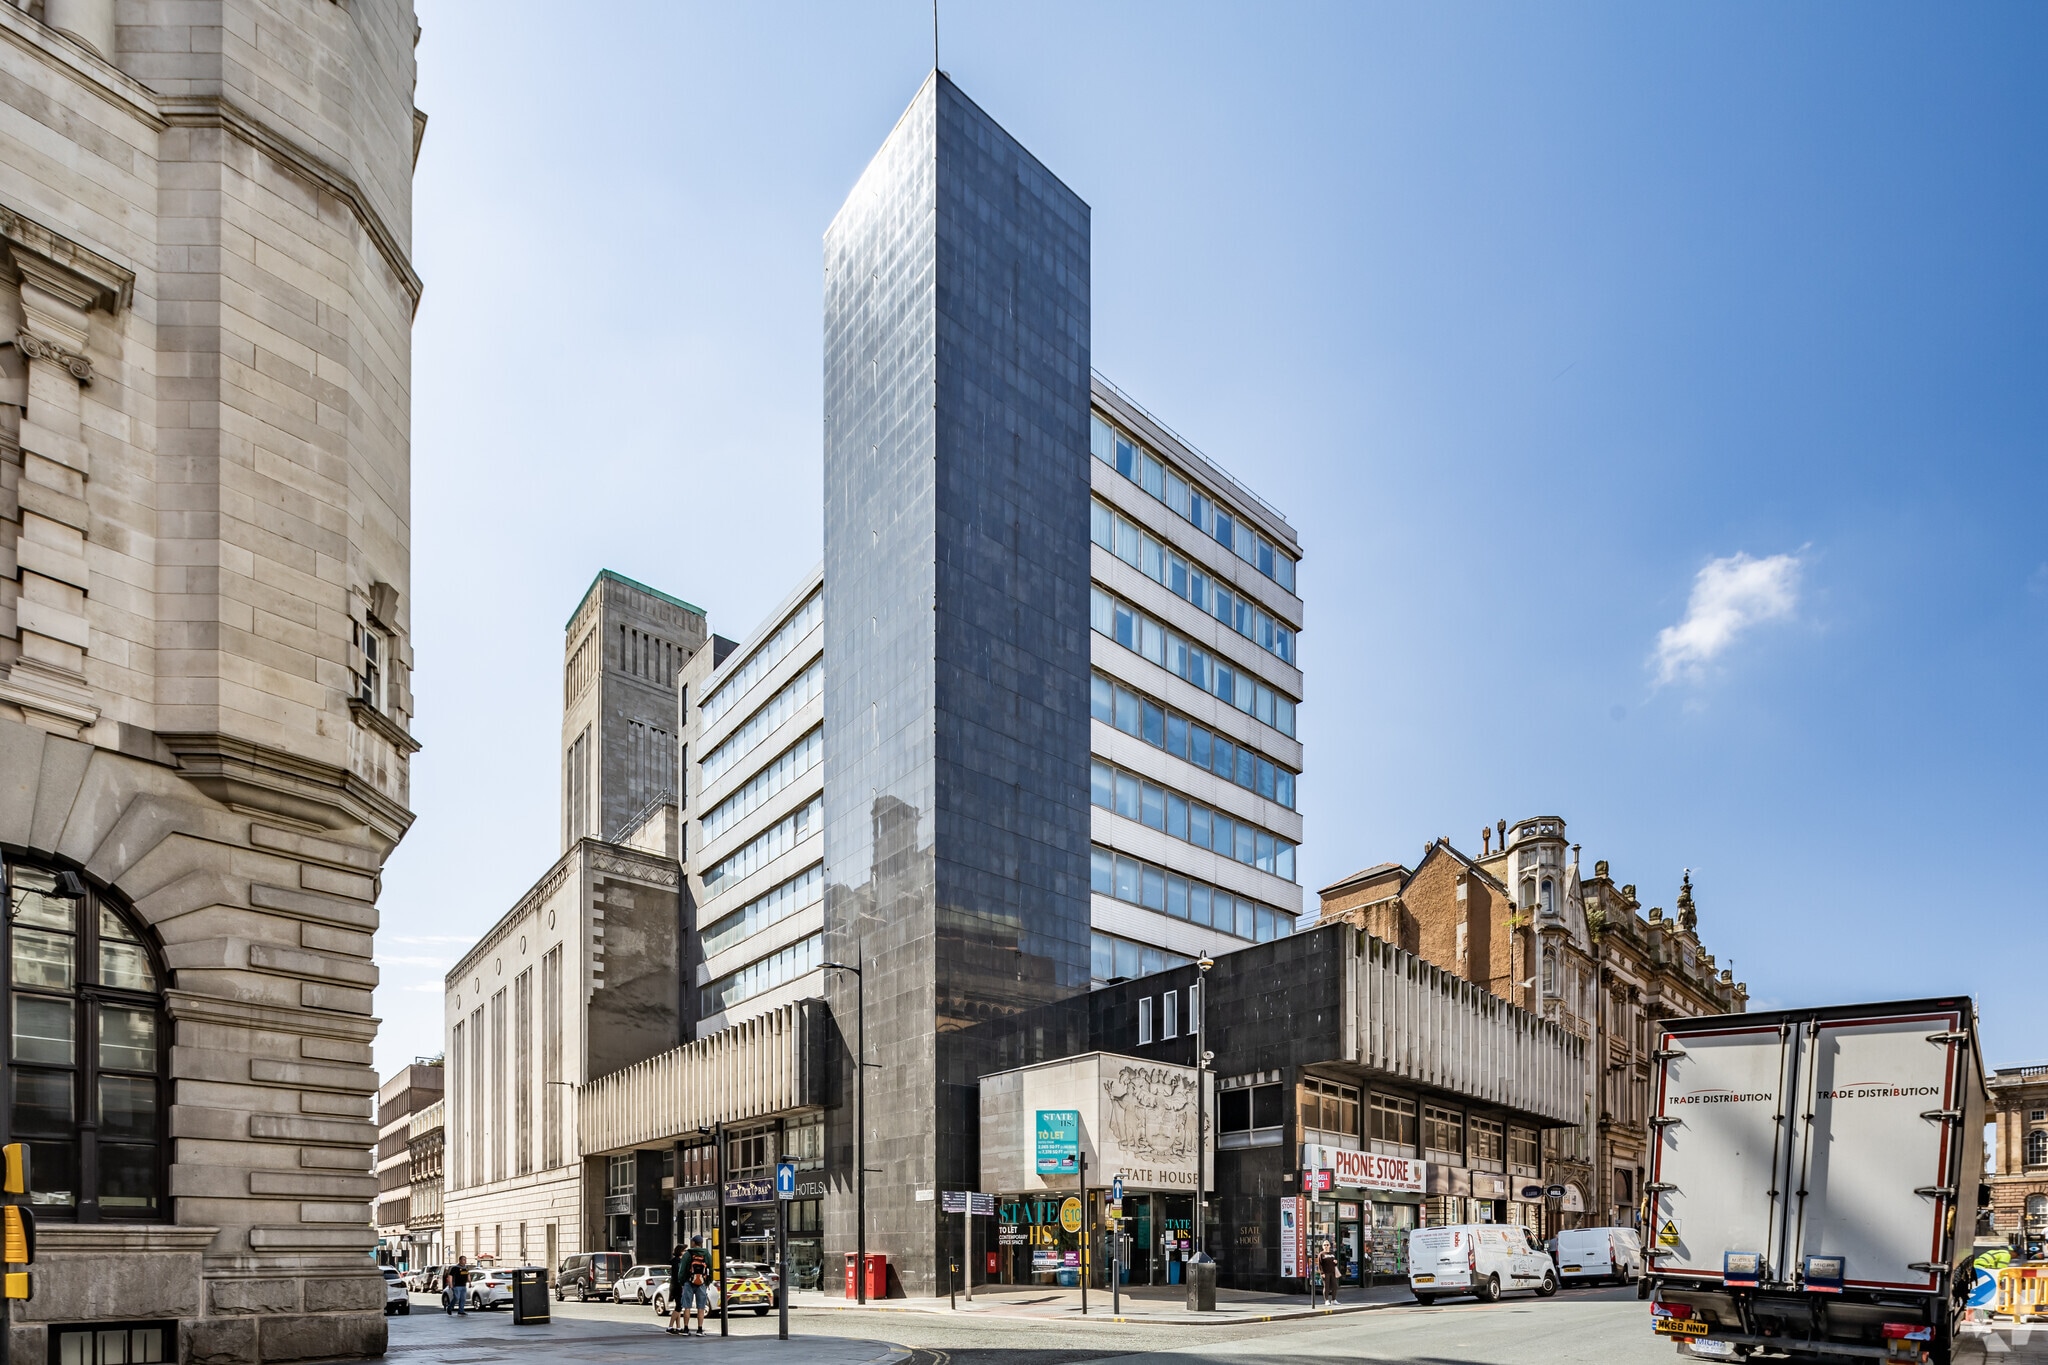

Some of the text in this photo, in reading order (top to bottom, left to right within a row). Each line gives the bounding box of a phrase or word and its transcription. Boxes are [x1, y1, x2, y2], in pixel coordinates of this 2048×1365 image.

[1668, 1091, 1772, 1105] TRADE DISTRIBUTION
[1817, 1084, 1940, 1100] TRADE DISTRIBUTION
[1043, 1112, 1074, 1121] STATE
[1038, 1131, 1065, 1140] TO LET
[1336, 1151, 1408, 1181] PHONE STORE
[1119, 1168, 1198, 1184] STATE HOUSE
[795, 1182, 824, 1196] HOTELS
[677, 1190, 716, 1204] HUMMINGBIRD
[999, 1202, 1059, 1225] STATE
[1164, 1218, 1191, 1229] STATE
[999, 1226, 1018, 1234] TO LET
[1029, 1225, 1058, 1246] HS.
[1177, 1229, 1191, 1239] HS.
[1240, 1226, 1260, 1235] STATE
[1239, 1236, 1260, 1245] HOUSE
[1658, 1320, 1684, 1331] MK68
